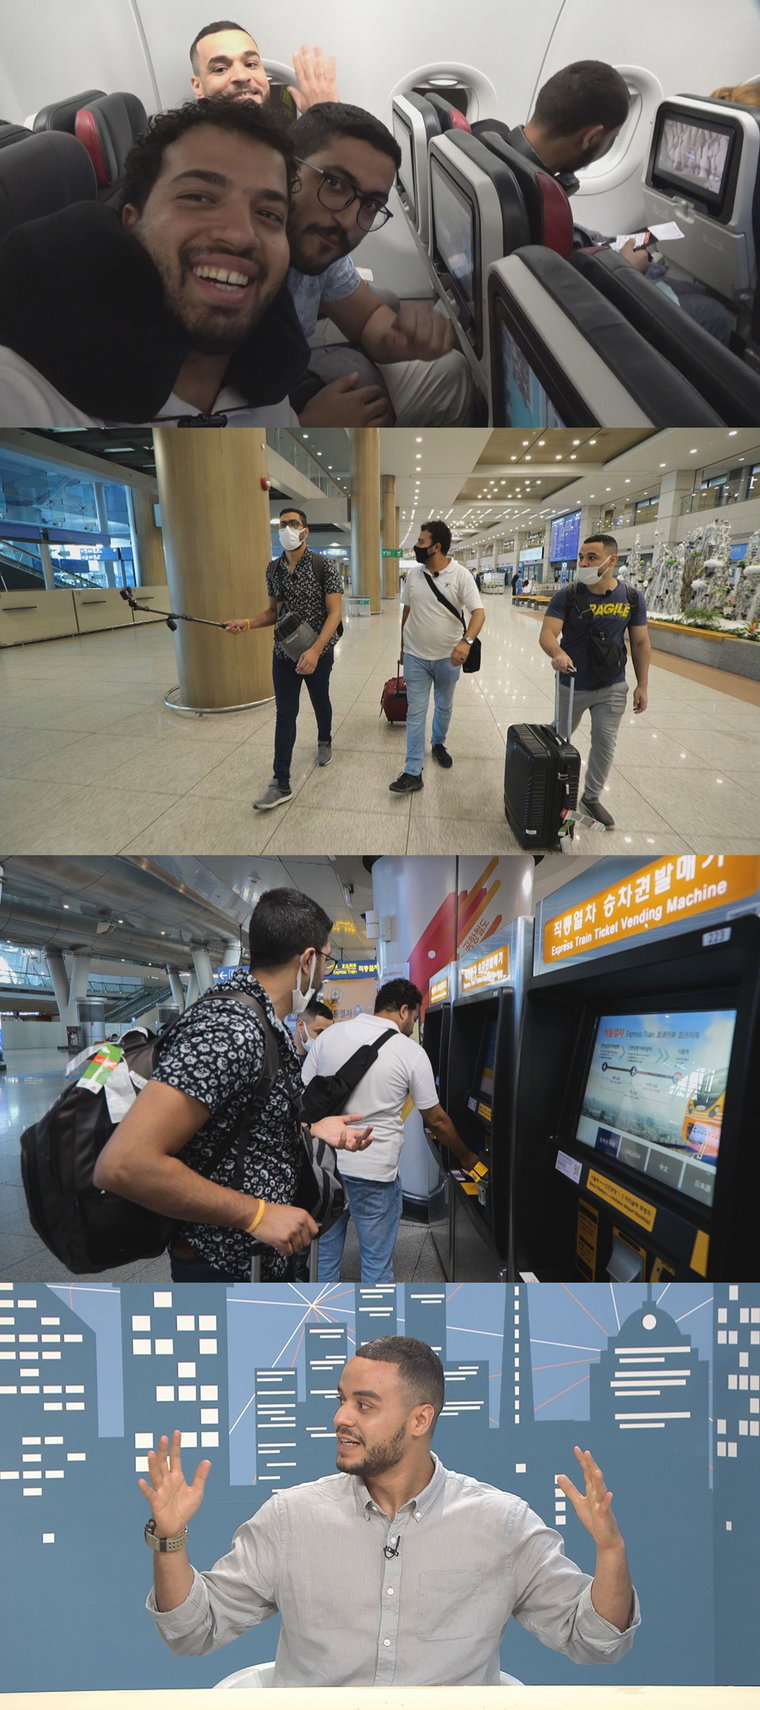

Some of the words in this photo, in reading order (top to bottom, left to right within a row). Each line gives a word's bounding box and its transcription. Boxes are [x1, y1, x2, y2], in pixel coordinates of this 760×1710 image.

[589, 602, 630, 618] RAGILE
[551, 940, 574, 957] Express
[575, 933, 592, 947] Train
[594, 920, 618, 940] Ticket
[621, 904, 663, 931] Vending
[666, 880, 727, 914] Machine
[553, 903, 597, 938] 직통열차
[333, 1009, 353, 1019] 통열차
